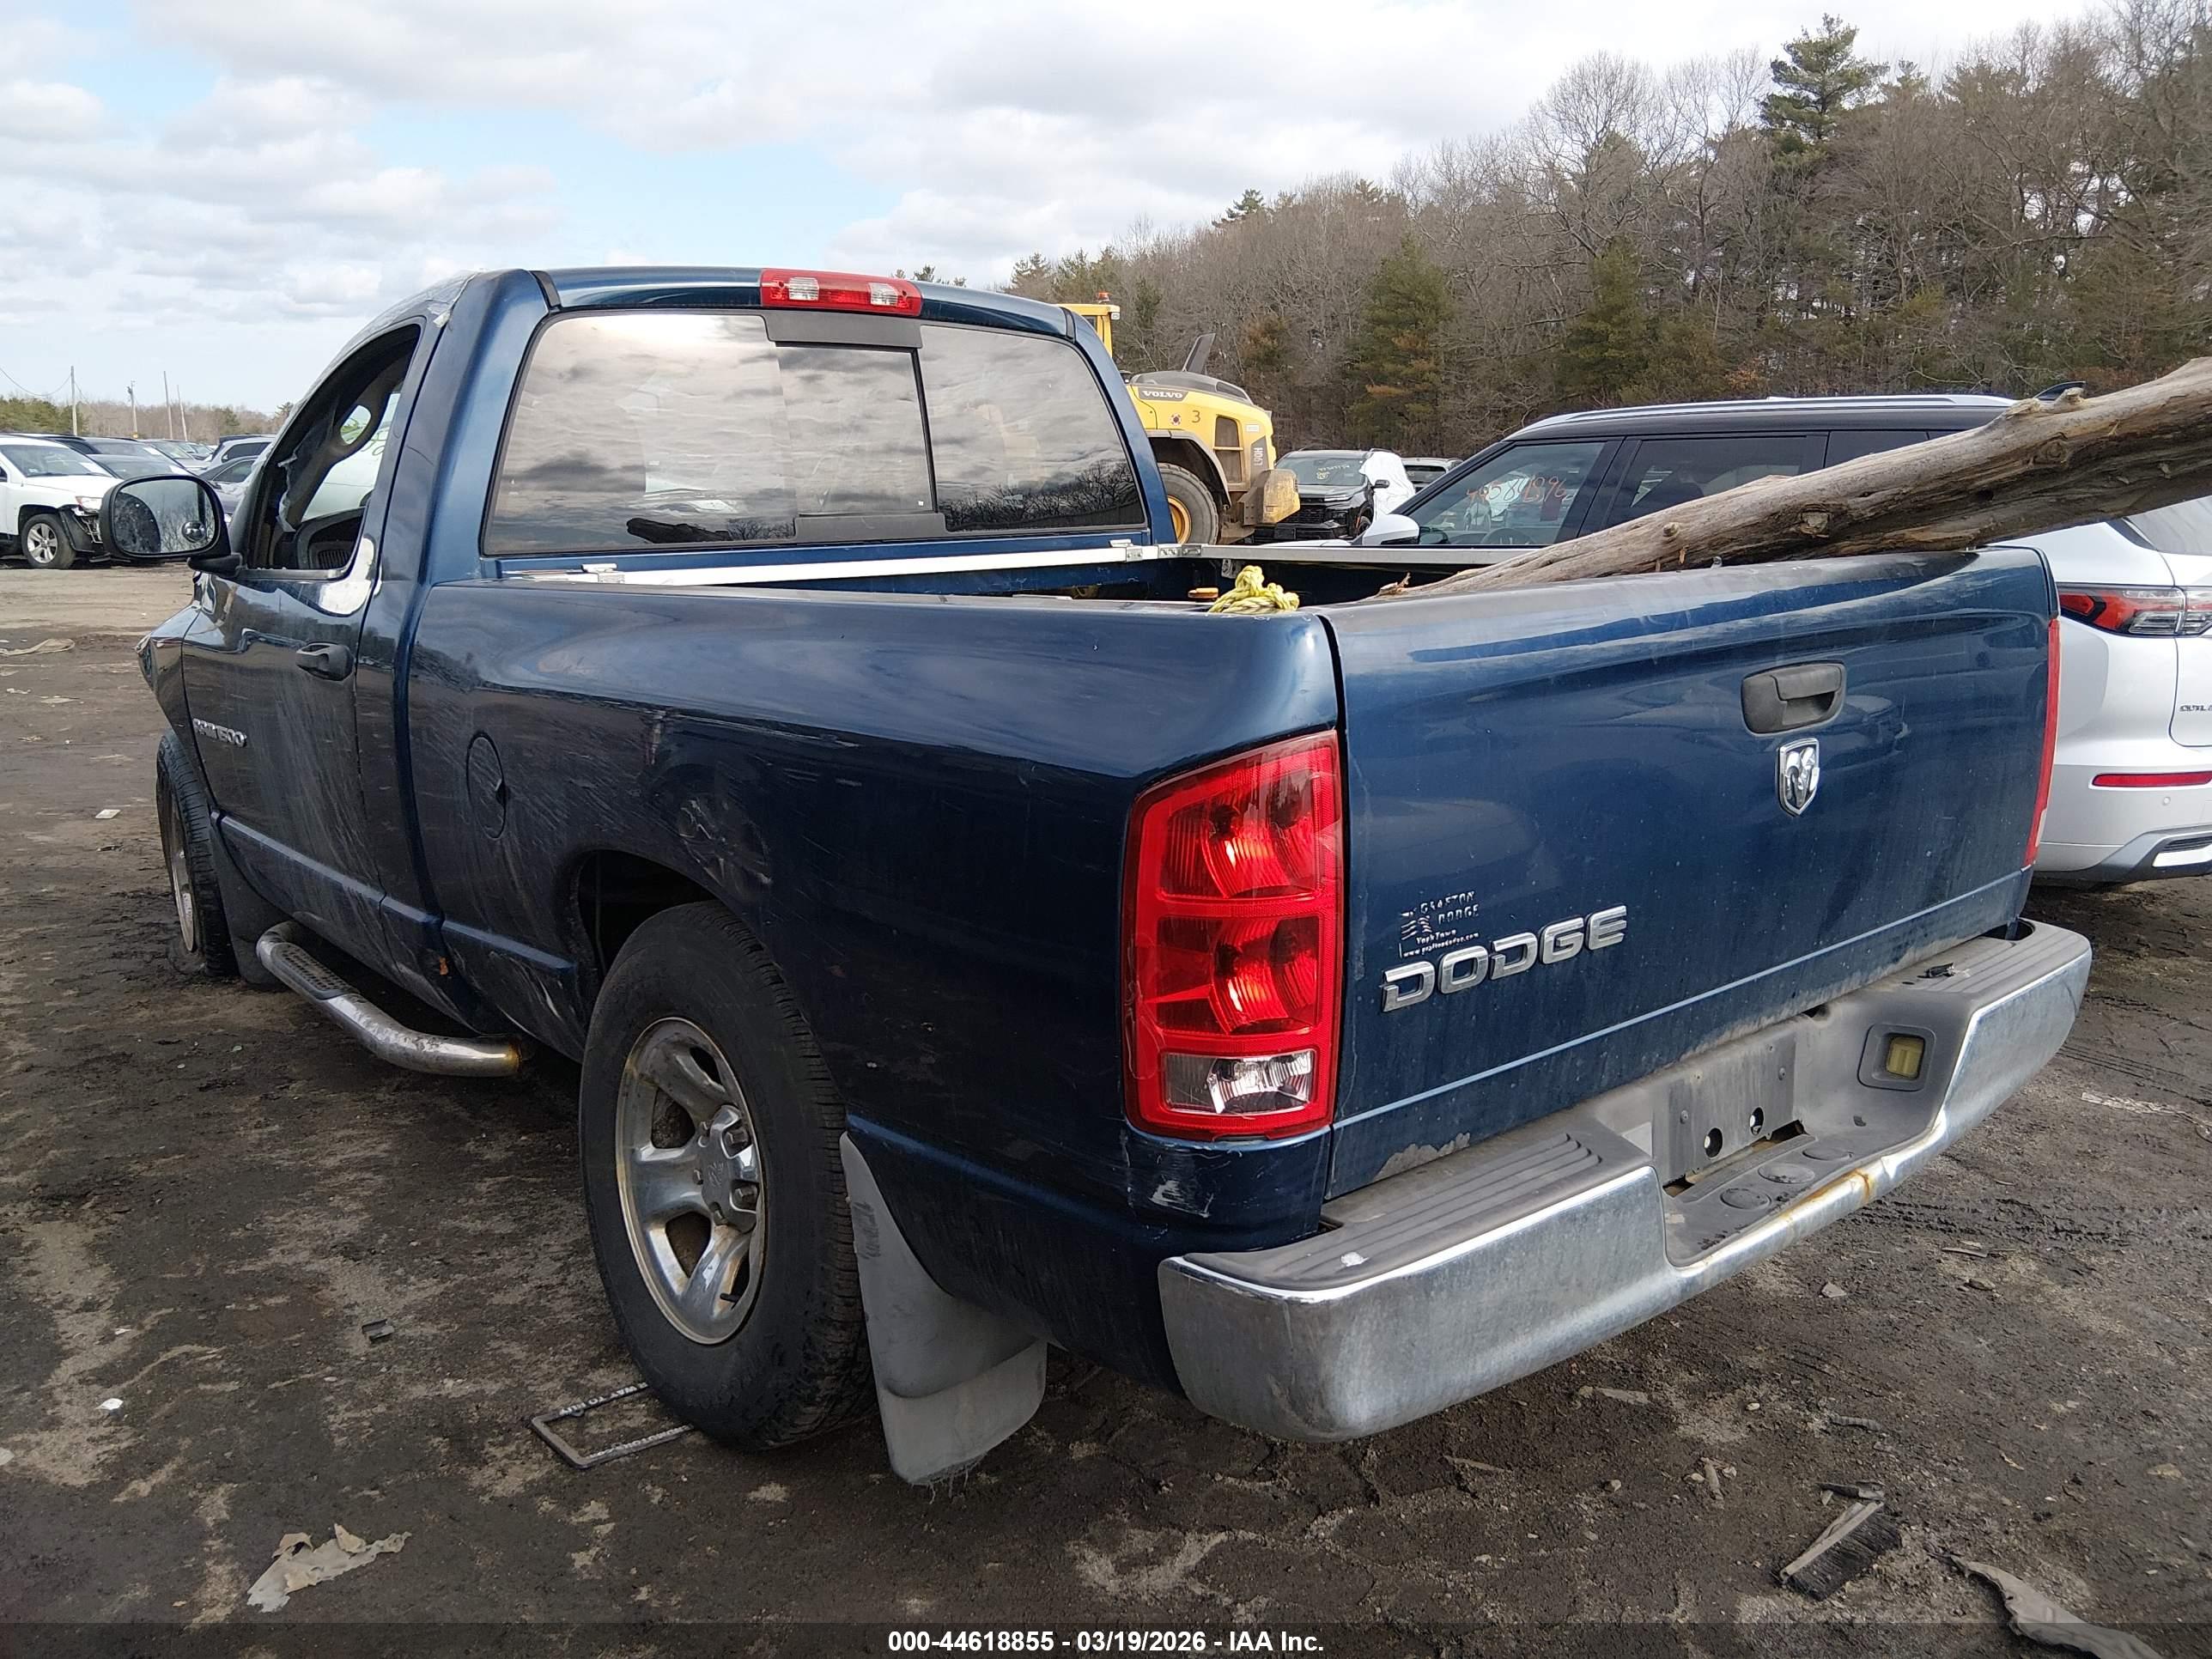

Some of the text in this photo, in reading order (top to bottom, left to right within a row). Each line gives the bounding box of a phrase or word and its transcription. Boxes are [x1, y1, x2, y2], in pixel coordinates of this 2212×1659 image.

[1142, 390, 1183, 399] VOLVO
[1191, 409, 1201, 423] 3
[1438, 903, 1480, 925] DODGE
[1382, 905, 1627, 1012] DODGE
